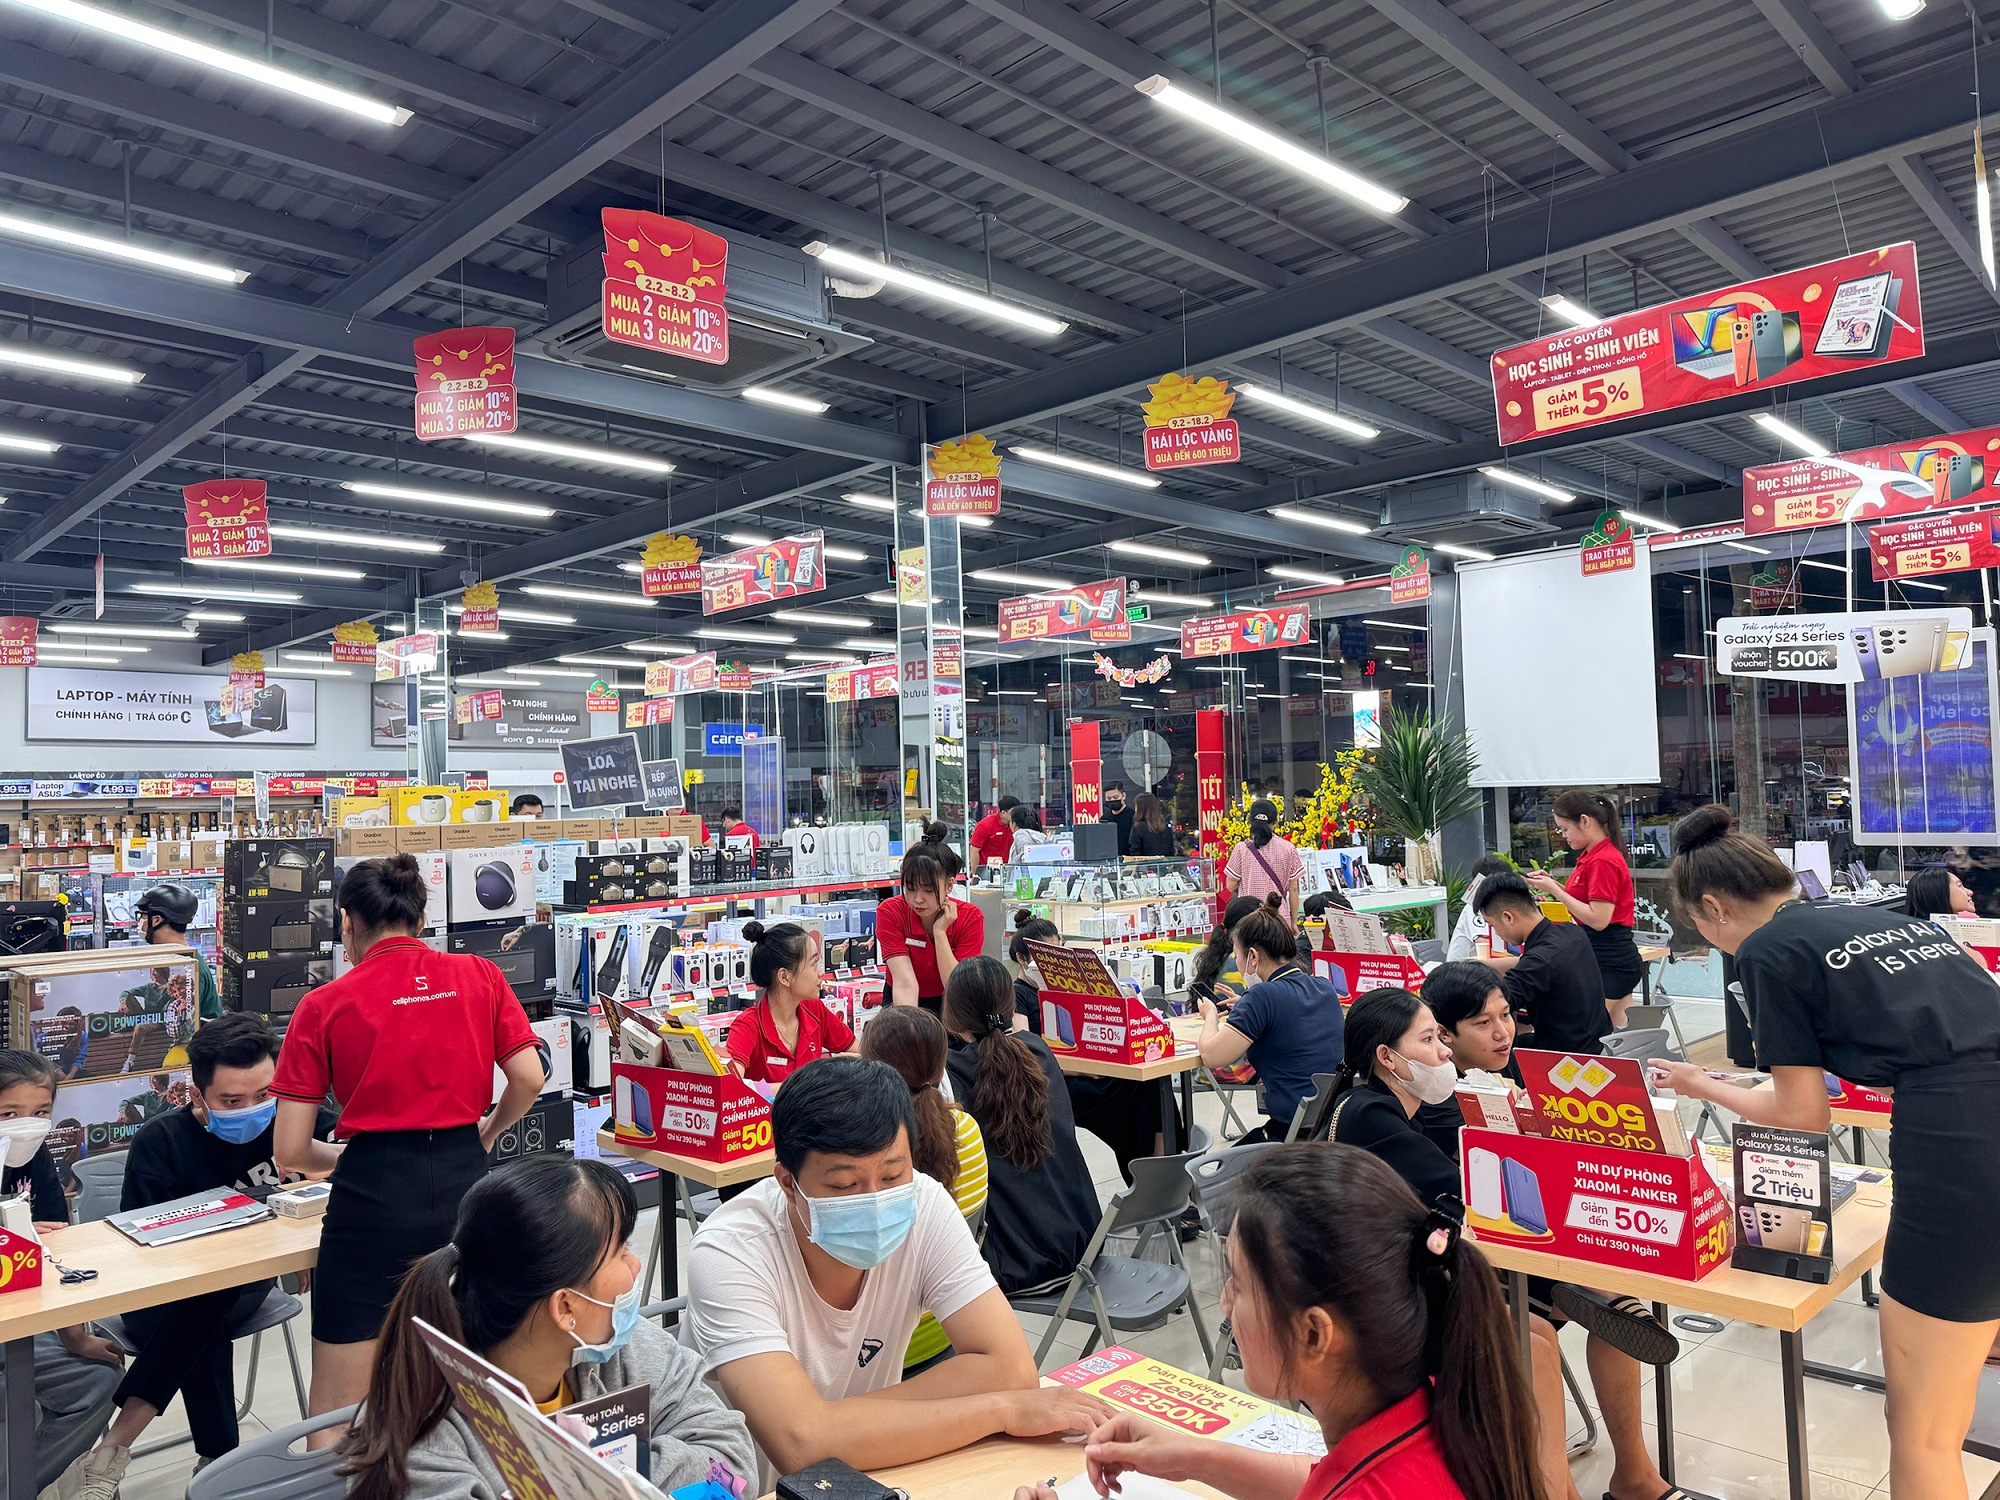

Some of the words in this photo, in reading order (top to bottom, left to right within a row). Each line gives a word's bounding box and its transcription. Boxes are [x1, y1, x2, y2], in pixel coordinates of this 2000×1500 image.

[610, 292, 640, 314] MUA
[643, 295, 653, 317] 2
[658, 303, 691, 326] GIẢM
[692, 307, 720, 330] 10%
[611, 316, 641, 338] MUA
[643, 319, 653, 340] 3
[658, 326, 691, 349] GIẢM
[692, 330, 722, 354] 20%
[1548, 338, 1572, 353] ĐẶC
[1574, 325, 1613, 344] QUYỀN
[1509, 361, 1537, 383] HỌC
[1539, 351, 1573, 373] SINH
[1584, 341, 1621, 362] SINH
[1622, 327, 1660, 351] VIÊN
[421, 401, 444, 415] MUA
[445, 396, 454, 413] 2
[457, 394, 484, 412] GIẢM
[485, 392, 510, 410] 10%
[1547, 389, 1577, 405] GIẢM
[1547, 404, 1579, 420] THÊM
[1582, 378, 1629, 416] 5%
[421, 420, 444, 434] MUA
[446, 415, 454, 432] 3
[458, 413, 485, 431] GIẢM
[485, 411, 511, 428] 20%
[1151, 432, 1172, 449] HÁI
[1175, 430, 1198, 448] LỘC
[1200, 427, 1233, 444] VÀNG
[1155, 451, 1172, 463] QUÀ
[1174, 448, 1190, 461] ĐẾN
[1192, 449, 1206, 459] 600
[1208, 445, 1232, 458] TRIỆU
[930, 485, 947, 499] HÁI
[950, 484, 967, 500] LỘC
[969, 484, 995, 497] VÀNG
[1786, 499, 1812, 510] GIẢM
[1880, 534, 1900, 546] HỌC
[1901, 530, 1925, 542] SINH
[1932, 526, 1957, 538] SINH
[1958, 522, 1982, 534] VIÊN
[1905, 560, 1928, 570] THÊM
[1929, 548, 1962, 569] 5%
[1906, 551, 1927, 561] GIẢM
[726, 584, 740, 604] 5%
[1741, 622, 1759, 631] Trải
[1761, 622, 1799, 633] nghiệm
[1801, 622, 1826, 632] ngay
[1211, 638, 1227, 651] 5%
[1723, 634, 1772, 646] Galaxy
[1775, 632, 1798, 643] S24
[1801, 630, 1845, 642] Series
[1733, 660, 1768, 668] voucher
[1777, 650, 1829, 668] 500K
[1739, 651, 1762, 659] Nhận
[56, 690, 114, 702] LAPTOP
[126, 690, 157, 704] MÁY
[160, 691, 192, 705] TÍNH
[512, 699, 525, 707] TAI
[526, 700, 548, 708] NGHE
[55, 709, 91, 720] CHÍNH
[93, 710, 123, 721] HÃNG
[136, 711, 156, 721] TRẢ
[158, 712, 179, 722] GÓP
[528, 712, 554, 722] CHÍNH
[555, 713, 577, 723] HÃNG
[711, 731, 743, 745] care
[587, 754, 616, 771] LOA
[378, 770, 390, 778] TẬP
[35, 782, 64, 790] Laptop
[573, 779, 597, 794] TAI
[598, 774, 638, 791] NGHE
[657, 786, 678, 799] DỤNG
[1201, 774, 1222, 800] TẾT
[37, 790, 62, 798] ASUS
[1202, 805, 1224, 831] NÀY
[1825, 927, 1915, 970] Galaxy
[1908, 921, 1934, 937] AI
[1873, 956, 1906, 975] is
[1898, 941, 1961, 964] here
[392, 990, 457, 1006] cellphones.com.vn
[114, 1012, 163, 1029] POWERFUL
[667, 1080, 679, 1089] PIN
[679, 1081, 689, 1091] DỰ
[690, 1083, 713, 1095] PHÒNG
[665, 1092, 688, 1102] XIAOMI
[692, 1096, 715, 1108] ANKER
[722, 1100, 737, 1112] Phụ
[738, 1096, 755, 1108] Kiện
[668, 1109, 683, 1119] Giảm
[672, 1117, 682, 1128] đến
[685, 1112, 710, 1130] 50%
[722, 1111, 746, 1126] CHÍNH
[747, 1105, 771, 1119] HÃNG
[1485, 1113, 1510, 1123] HELLO
[1538, 1093, 1647, 1132] 500K
[722, 1129, 741, 1141] Giảm
[726, 1140, 742, 1152] Đến
[742, 1120, 772, 1151] 50
[1736, 1138, 1772, 1152] Galaxy
[1773, 1142, 1791, 1153] S24
[1793, 1145, 1826, 1158] Series
[1577, 1161, 1599, 1174] PIN
[1601, 1164, 1623, 1179] DỰ
[1624, 1167, 1673, 1186] PHÒNG
[1758, 1166, 1781, 1176] Giảm
[1781, 1169, 1804, 1179] thêm
[1573, 1177, 1620, 1194] XIAOMI
[1631, 1188, 1678, 1204] ANKER
[1751, 1174, 1767, 1196] 2
[1769, 1180, 1813, 1202] Triệu
[1580, 1201, 1608, 1215] Giảm
[1694, 1208, 1710, 1228] CHÍNH
[1709, 1200, 1725, 1219] HÃNG
[1588, 1214, 1609, 1228] đến
[1614, 1206, 1668, 1235] 50%
[1576, 1233, 1594, 1245] Chỉ
[1595, 1234, 1608, 1247] từ
[1609, 1238, 1630, 1251] 390
[1631, 1243, 1660, 1257] Ngàn
[1695, 1234, 1709, 1250] Giảm
[1119, 1383, 1139, 1395] Giá
[1147, 1364, 1177, 1381] Dán
[1178, 1373, 1228, 1400] Cường
[1229, 1393, 1259, 1412] Lực
[1149, 1378, 1225, 1412] Zeelot
[1112, 1389, 1129, 1399] từ
[1129, 1391, 1221, 1432] 350K
[601, 1412, 645, 1438] Series
[605, 1445, 623, 1458] VNPAY
